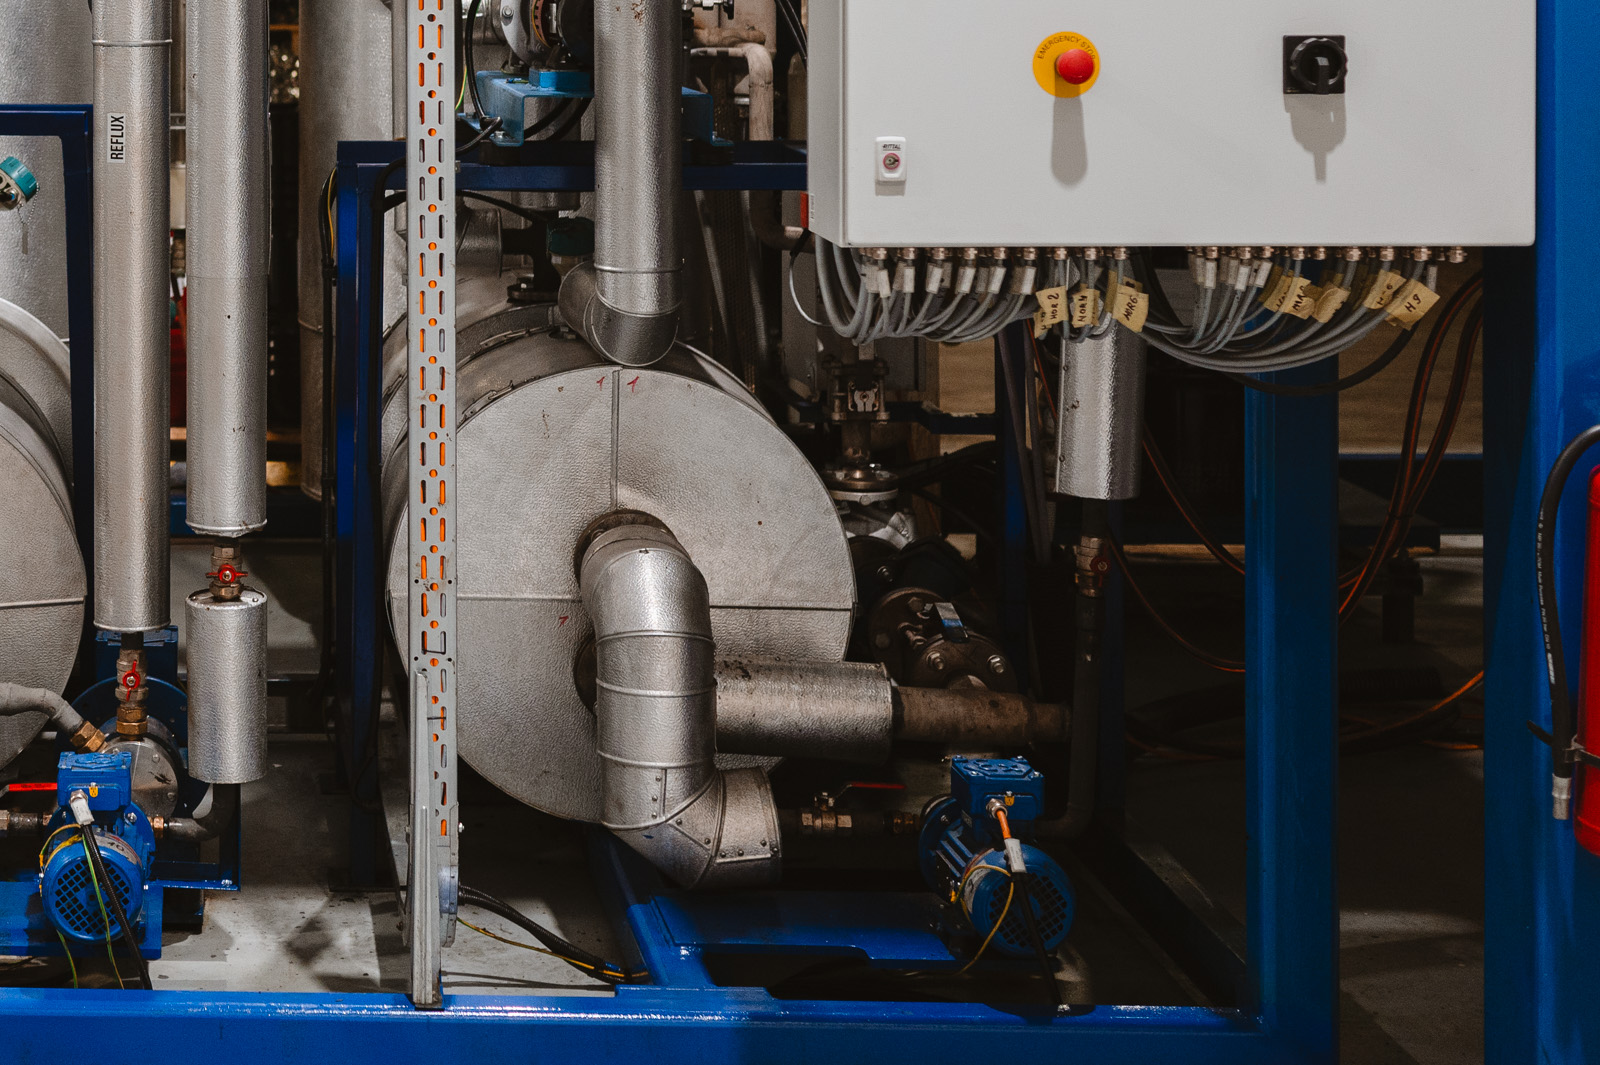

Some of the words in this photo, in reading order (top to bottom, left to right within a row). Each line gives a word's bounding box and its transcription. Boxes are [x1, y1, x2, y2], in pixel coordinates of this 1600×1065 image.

[1037, 35, 1082, 60] EMERGENCY
[110, 115, 124, 160] REFLUX
[1047, 292, 1060, 300] 2
